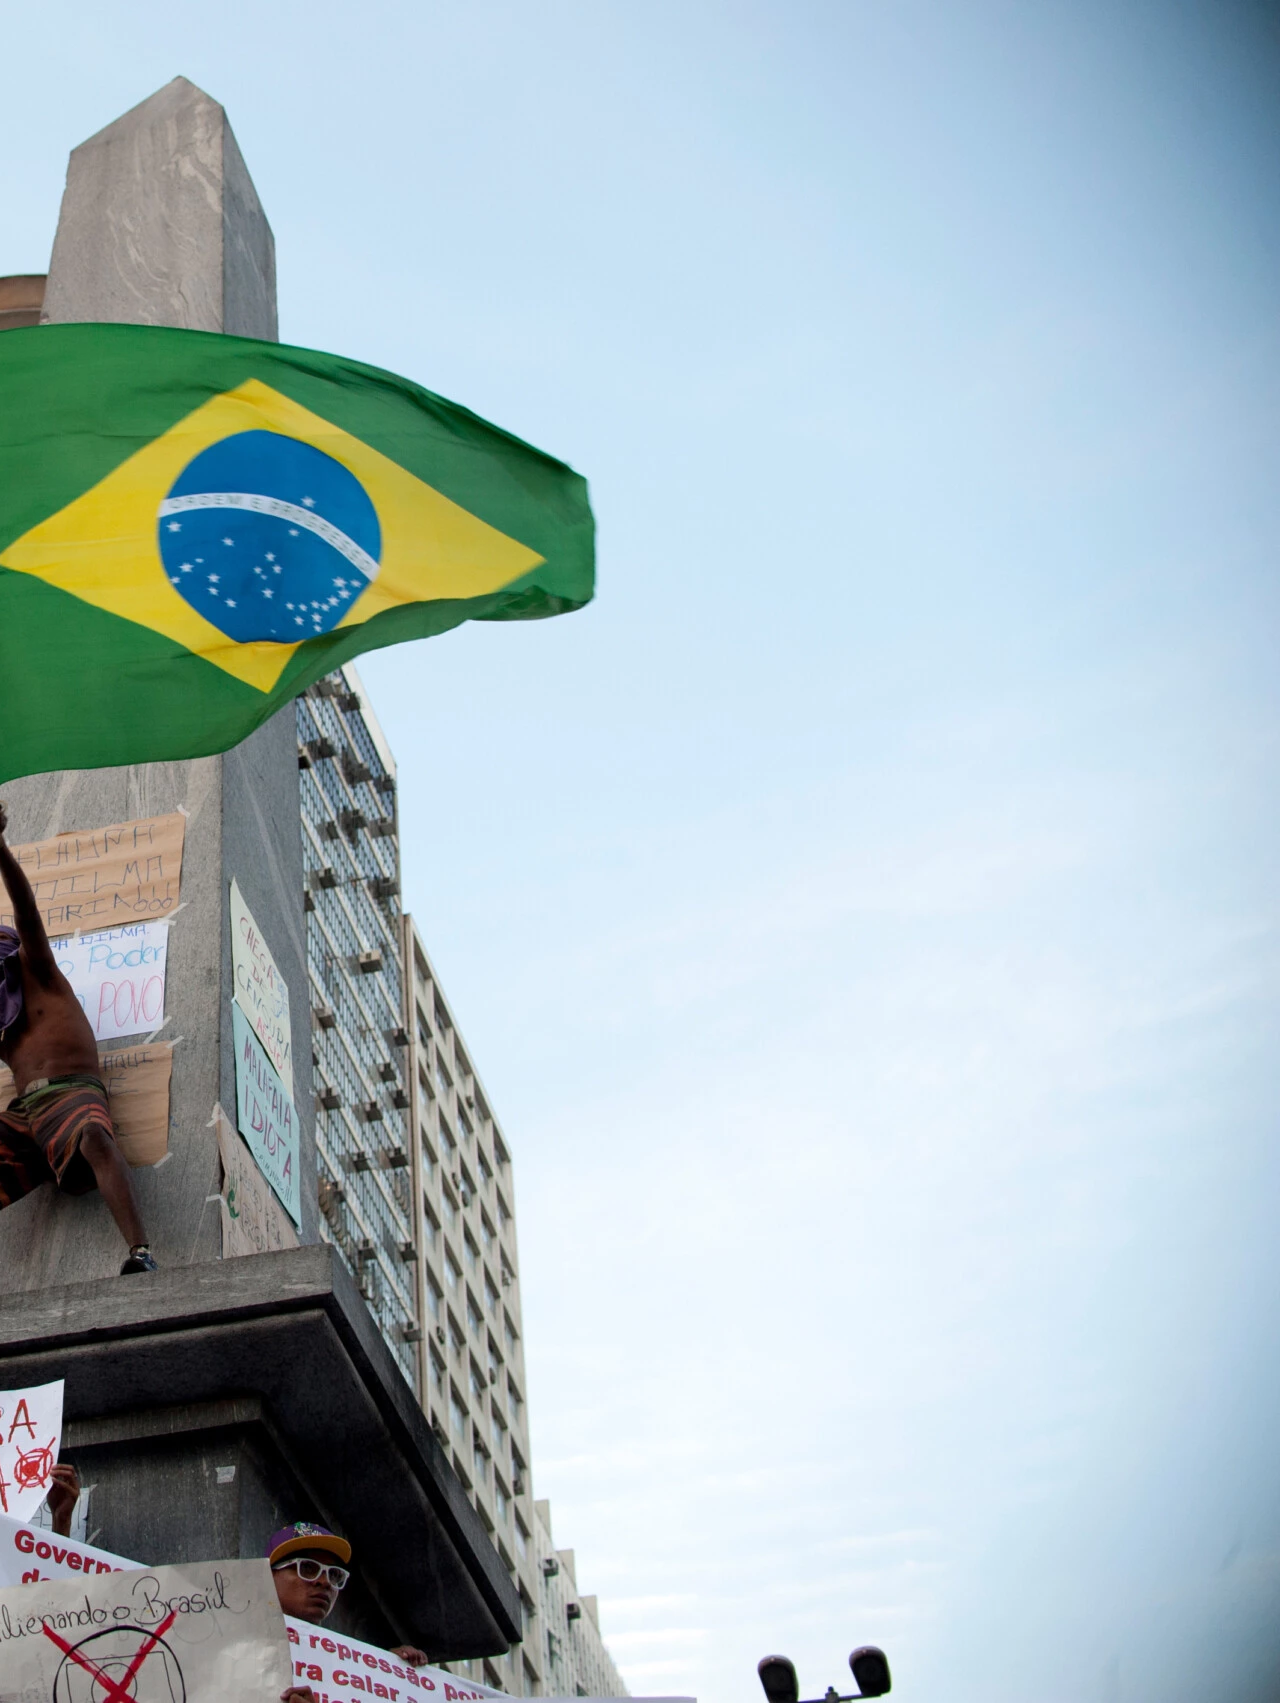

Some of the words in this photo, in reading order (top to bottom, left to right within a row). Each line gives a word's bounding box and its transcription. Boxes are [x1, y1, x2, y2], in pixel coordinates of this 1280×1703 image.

[169, 494, 244, 510] ORDEM
[250, 496, 264, 510] E
[269, 499, 373, 572] PROGRESSO
[30, 855, 163, 901] DILMA
[88, 940, 166, 974] Poder
[111, 1604, 130, 1620] o
[308, 1634, 437, 1692] repressão
[331, 1670, 401, 1703] calar
